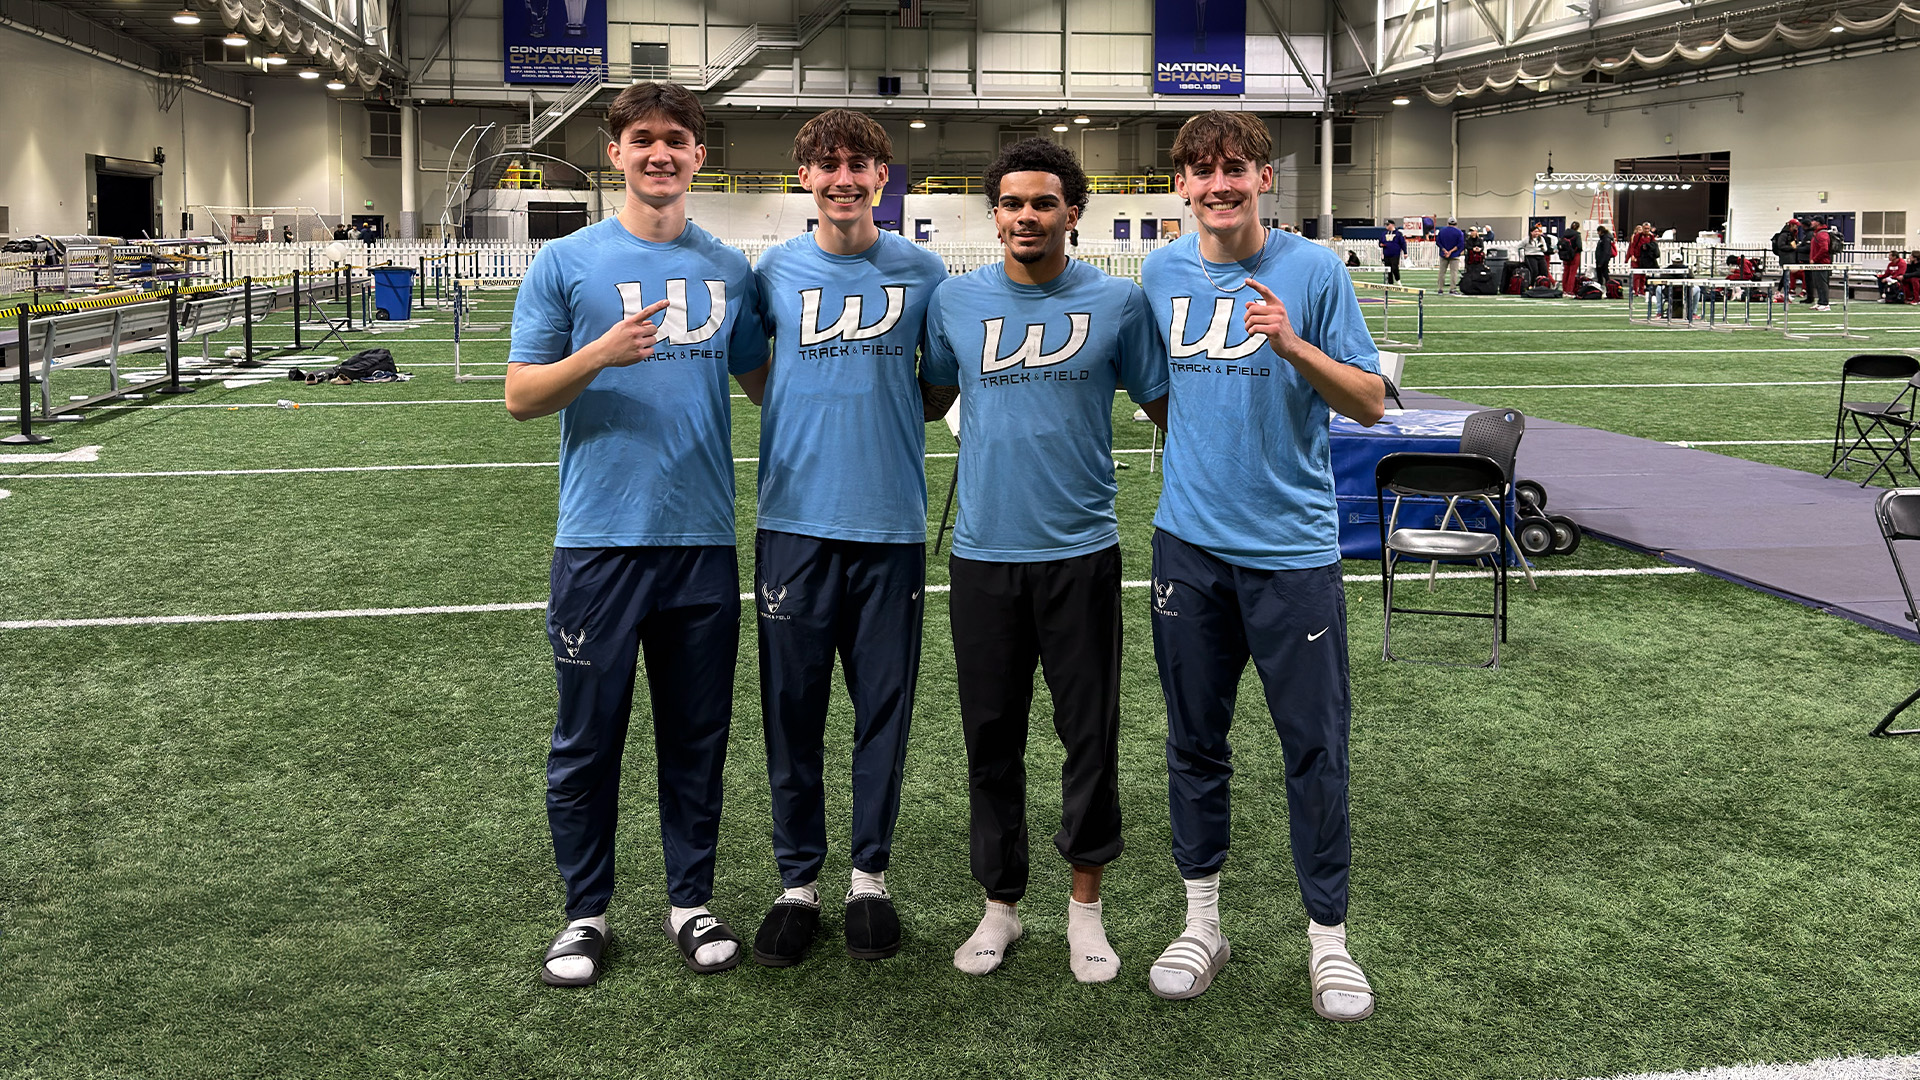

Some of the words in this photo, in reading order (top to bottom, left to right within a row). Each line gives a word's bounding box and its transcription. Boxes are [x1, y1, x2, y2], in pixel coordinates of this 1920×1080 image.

[509, 46, 602, 54] CONFERENCE
[510, 54, 602, 65] CHAMPS
[1157, 62, 1242, 72] NATIONAL
[1158, 72, 1242, 82] CHAMPS
[1370, 284, 1402, 292] WASHINGTON
[614, 278, 727, 346] W
[798, 285, 907, 347] W
[980, 312, 1092, 375] W
[680, 350, 686, 359] &
[799, 346, 850, 361] TRACK
[852, 346, 858, 355] &
[862, 344, 904, 356] FIELD
[1170, 362, 1211, 374] TRACK
[1215, 366, 1222, 374] &
[1226, 365, 1271, 377] FIELD
[980, 372, 1030, 389] TRACK
[1034, 372, 1040, 381] &
[1044, 369, 1089, 382] FIELD
[696, 917, 718, 930] NIKE
[558, 930, 587, 943] NIKE
